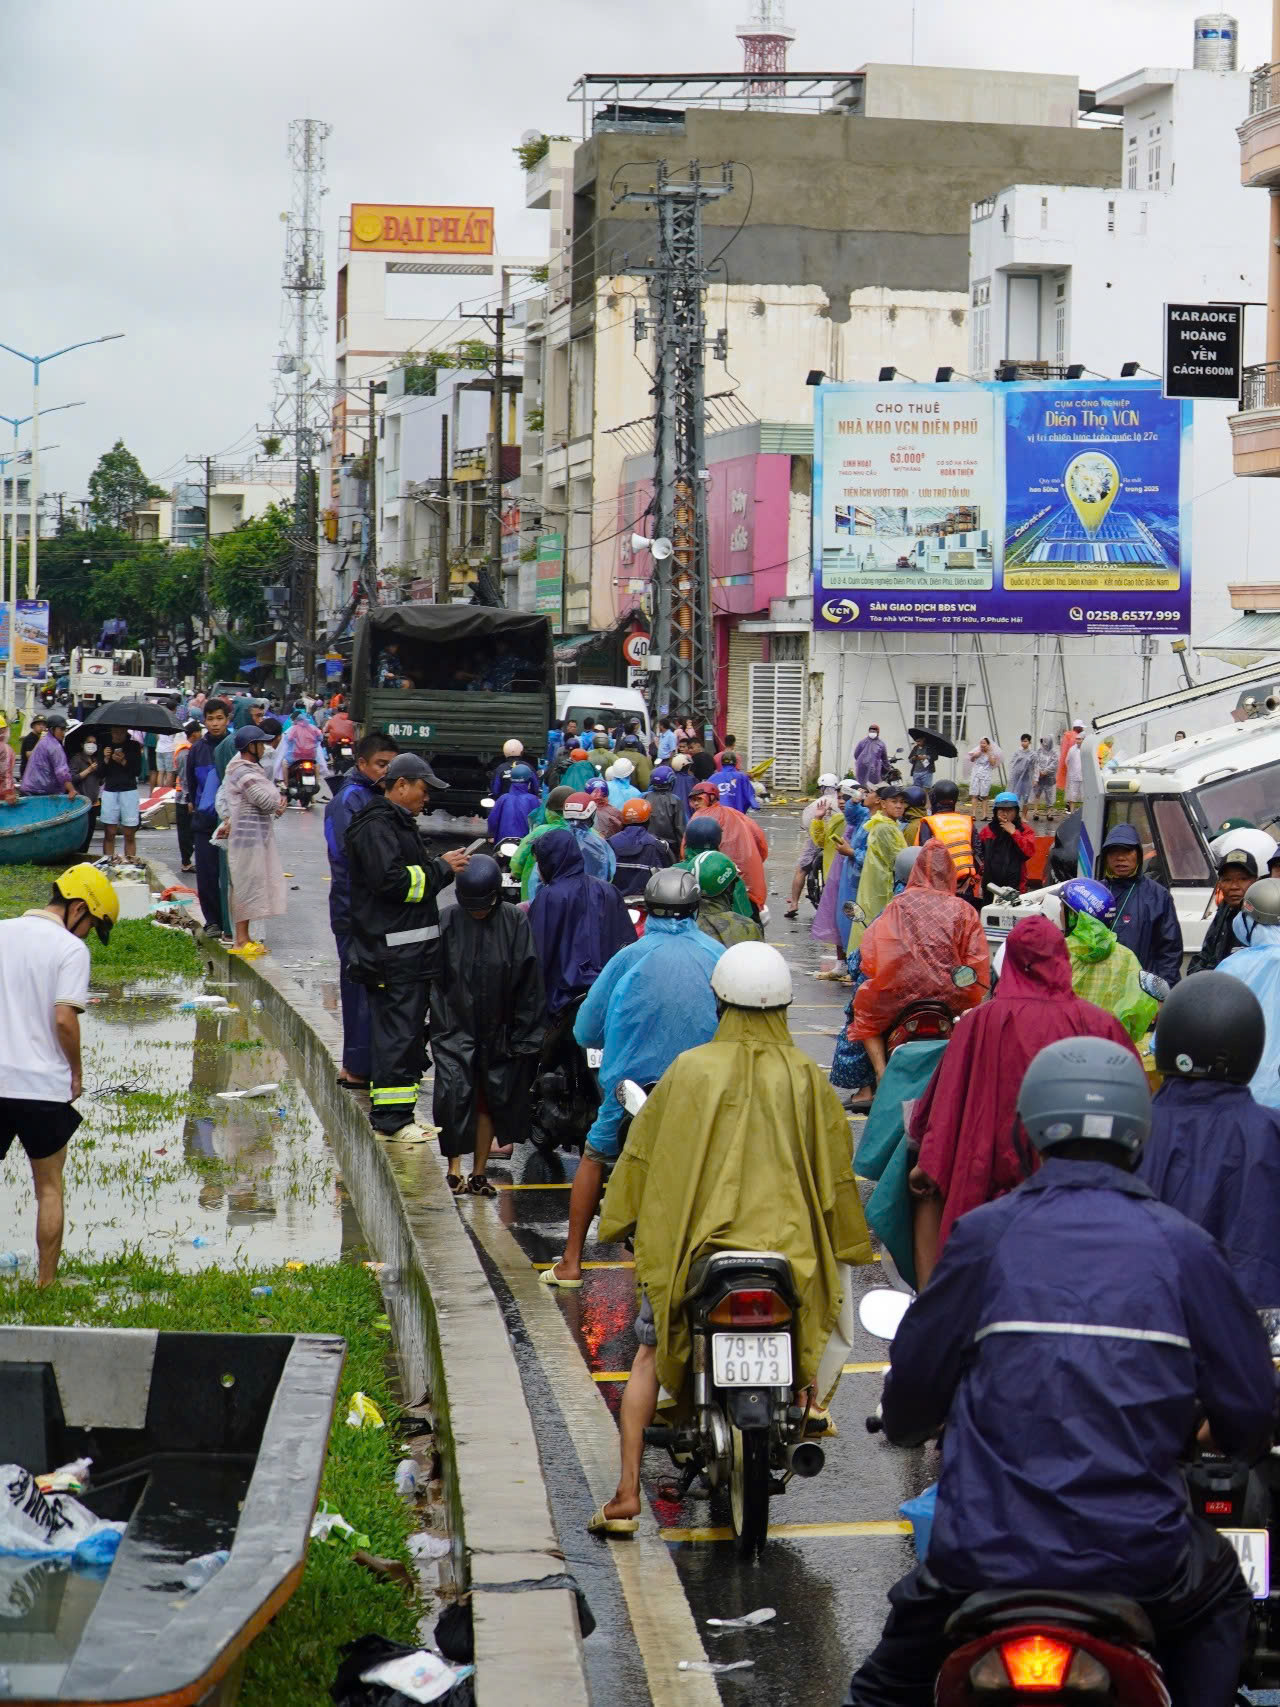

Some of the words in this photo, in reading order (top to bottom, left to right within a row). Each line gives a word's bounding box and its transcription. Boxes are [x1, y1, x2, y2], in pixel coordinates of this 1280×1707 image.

[383, 215, 425, 246] ĐẠI
[427, 211, 489, 244] PHÁT
[1171, 311, 1237, 323] KARAOKE
[1180, 327, 1227, 342] HOÀNG
[1191, 344, 1217, 361] YẾN
[1172, 363, 1203, 374] CÁCH
[1205, 366, 1234, 376] 600M
[876, 403, 904, 414] CHO
[908, 401, 941, 414] THUÊ
[1075, 399, 1099, 408] CÔNG
[838, 417, 864, 435] NHÀ
[866, 420, 892, 435] KHO
[895, 420, 920, 435] VCN
[1081, 410, 1108, 431] Thọ
[1112, 410, 1140, 427] VCN
[828, 607, 851, 615] VCN
[870, 602, 888, 612] SÀN
[889, 604, 913, 612] GIAO
[914, 604, 936, 614] DỊCH
[938, 604, 956, 612] BĐS
[958, 604, 977, 612] VCN
[1086, 610, 1181, 621] 0258.6537.999
[633, 641, 648, 656] 40
[716, 867, 733, 885] Grab
[718, 1258, 765, 1266] HONDA
[724, 1337, 779, 1359] 79-K5
[725, 1361, 780, 1382] 6073
